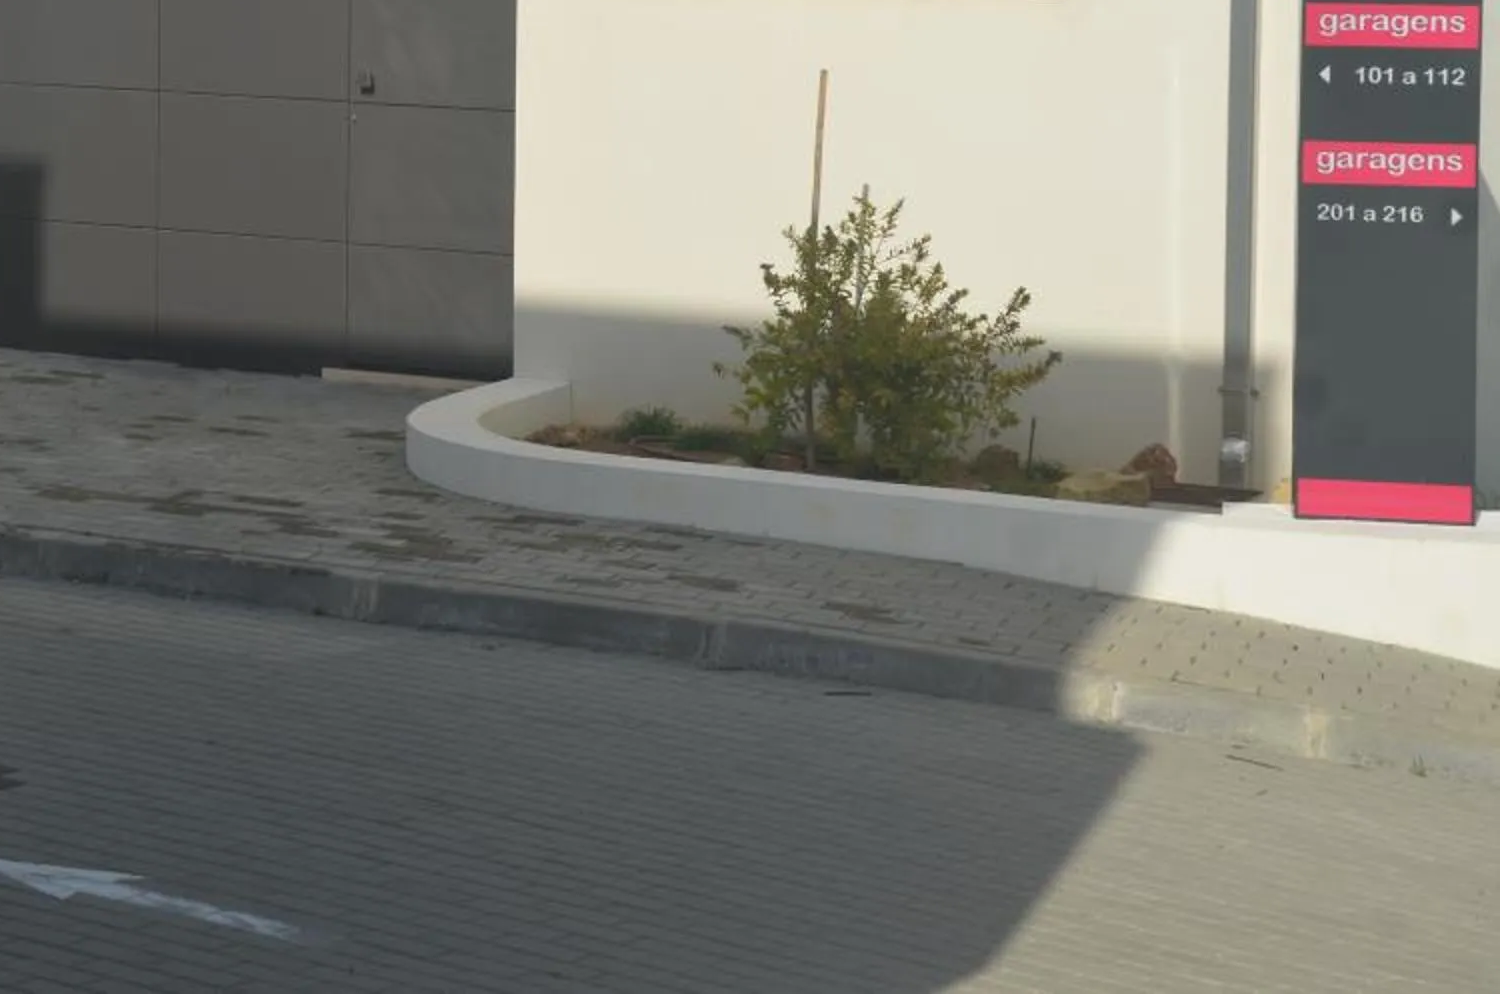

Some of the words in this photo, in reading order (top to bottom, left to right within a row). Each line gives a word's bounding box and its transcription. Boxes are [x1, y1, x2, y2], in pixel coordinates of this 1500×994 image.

[1319, 12, 1466, 38] garagens
[1355, 66, 1395, 85] 101
[1402, 71, 1417, 86] a
[1424, 67, 1466, 86] 112
[1316, 150, 1464, 177] garagens
[1316, 203, 1355, 222] 201
[1363, 208, 1377, 223] a
[1382, 205, 1424, 223] 216
